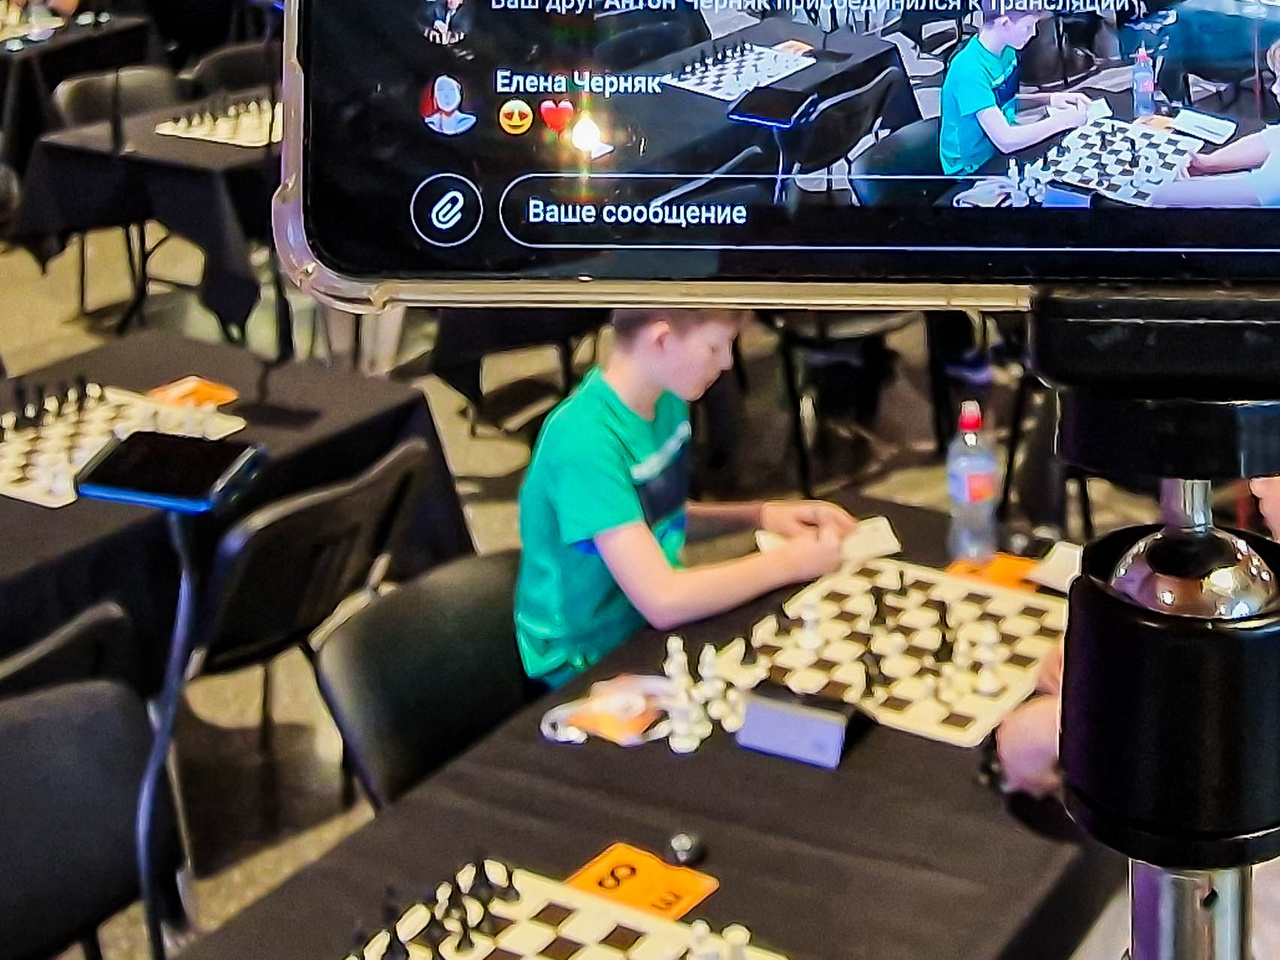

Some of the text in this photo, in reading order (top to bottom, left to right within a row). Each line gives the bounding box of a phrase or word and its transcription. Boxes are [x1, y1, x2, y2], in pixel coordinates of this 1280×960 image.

[496, 70, 662, 96] Елена Черняк
[528, 199, 748, 226] Ваше сообщение
